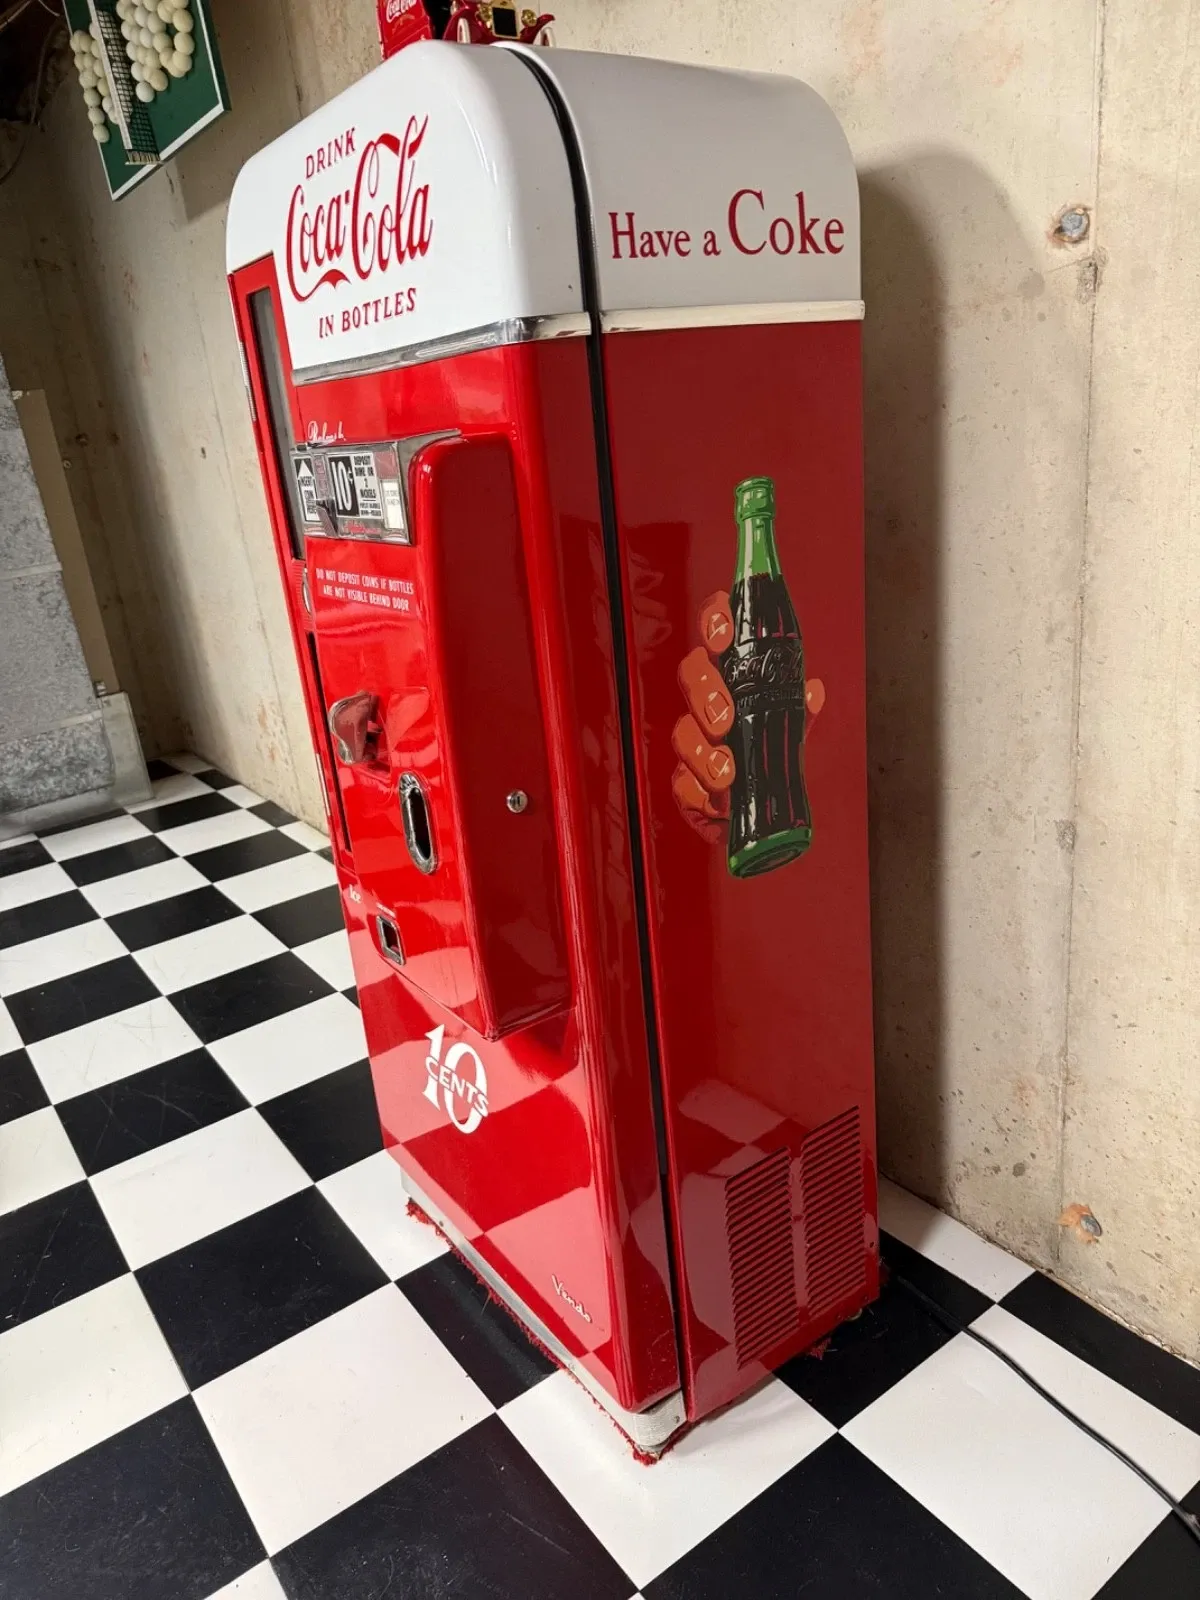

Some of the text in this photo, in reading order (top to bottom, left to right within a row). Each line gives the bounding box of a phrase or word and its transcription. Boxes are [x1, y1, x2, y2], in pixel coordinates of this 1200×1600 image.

[305, 126, 356, 180] DRINK
[608, 188, 845, 259] Have a Coke
[318, 287, 417, 339] IN BOTTLES
[353, 455, 371, 466] DEPOSIT
[360, 489, 377, 499] NICKELS
[316, 568, 414, 595] DO NOT DEPOSIT COINS IF BOTTLES
[323, 585, 409, 611] ARE NOT VISIBLE BEHIND DOOR
[422, 1023, 488, 1134] 10
[425, 1055, 489, 1119] CENTS
[551, 1273, 593, 1324] Vendo
